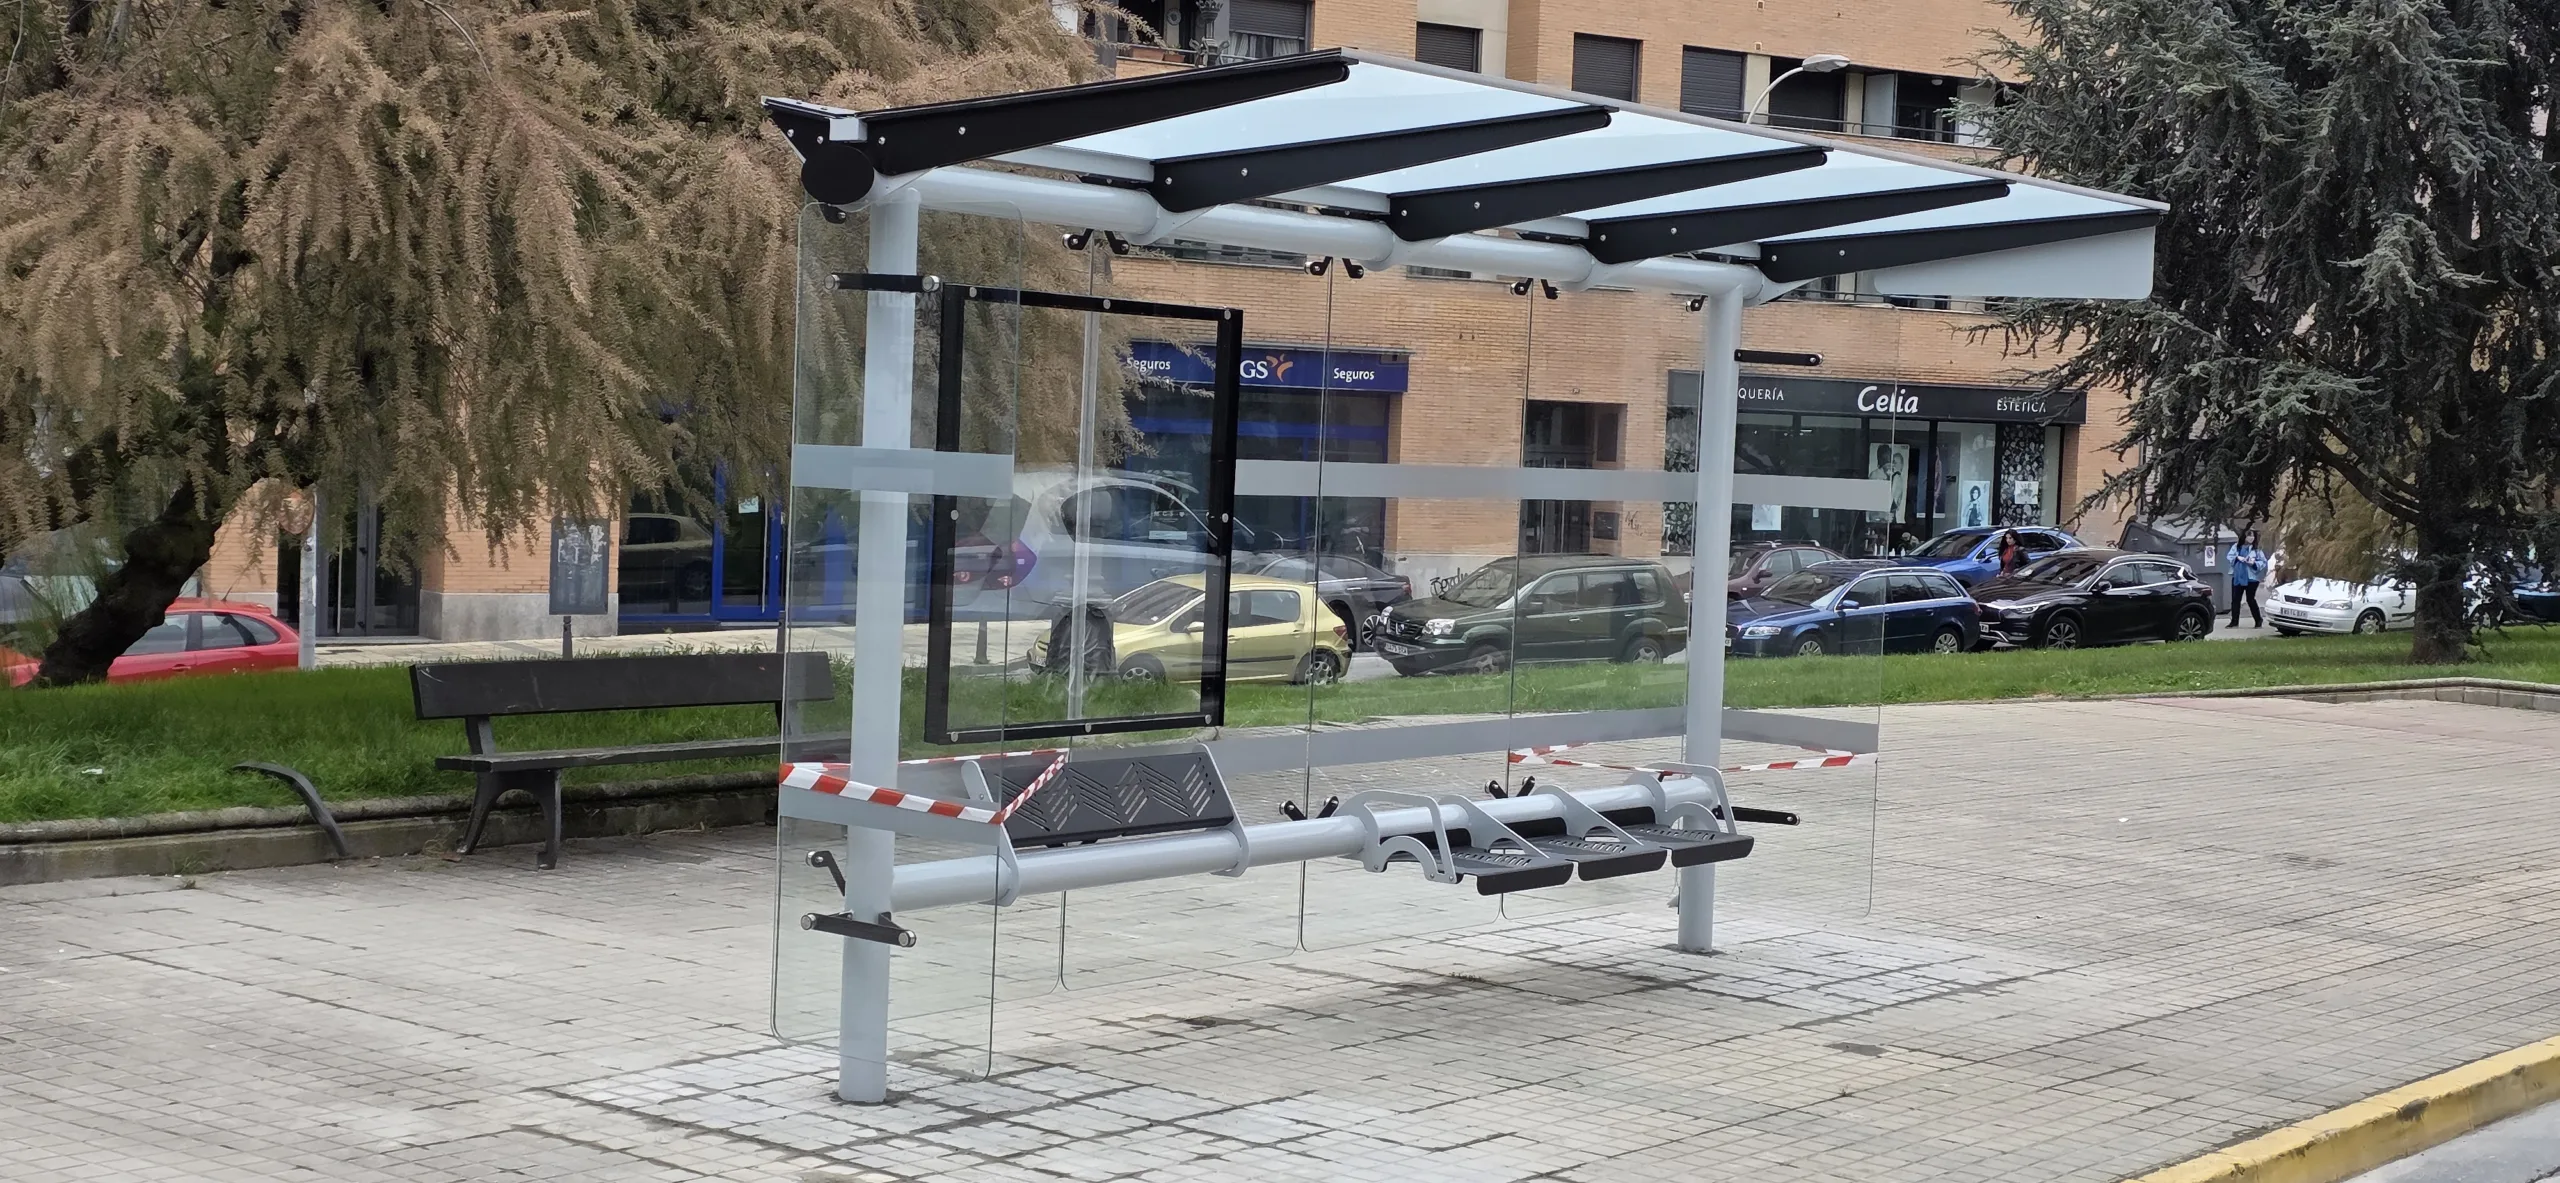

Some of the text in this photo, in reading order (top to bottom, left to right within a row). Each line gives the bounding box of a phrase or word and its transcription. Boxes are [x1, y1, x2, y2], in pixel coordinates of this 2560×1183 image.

[1126, 356, 1171, 372] Seguros
[1333, 367, 1375, 383] Seguros
[1857, 385, 1919, 413] Celia
